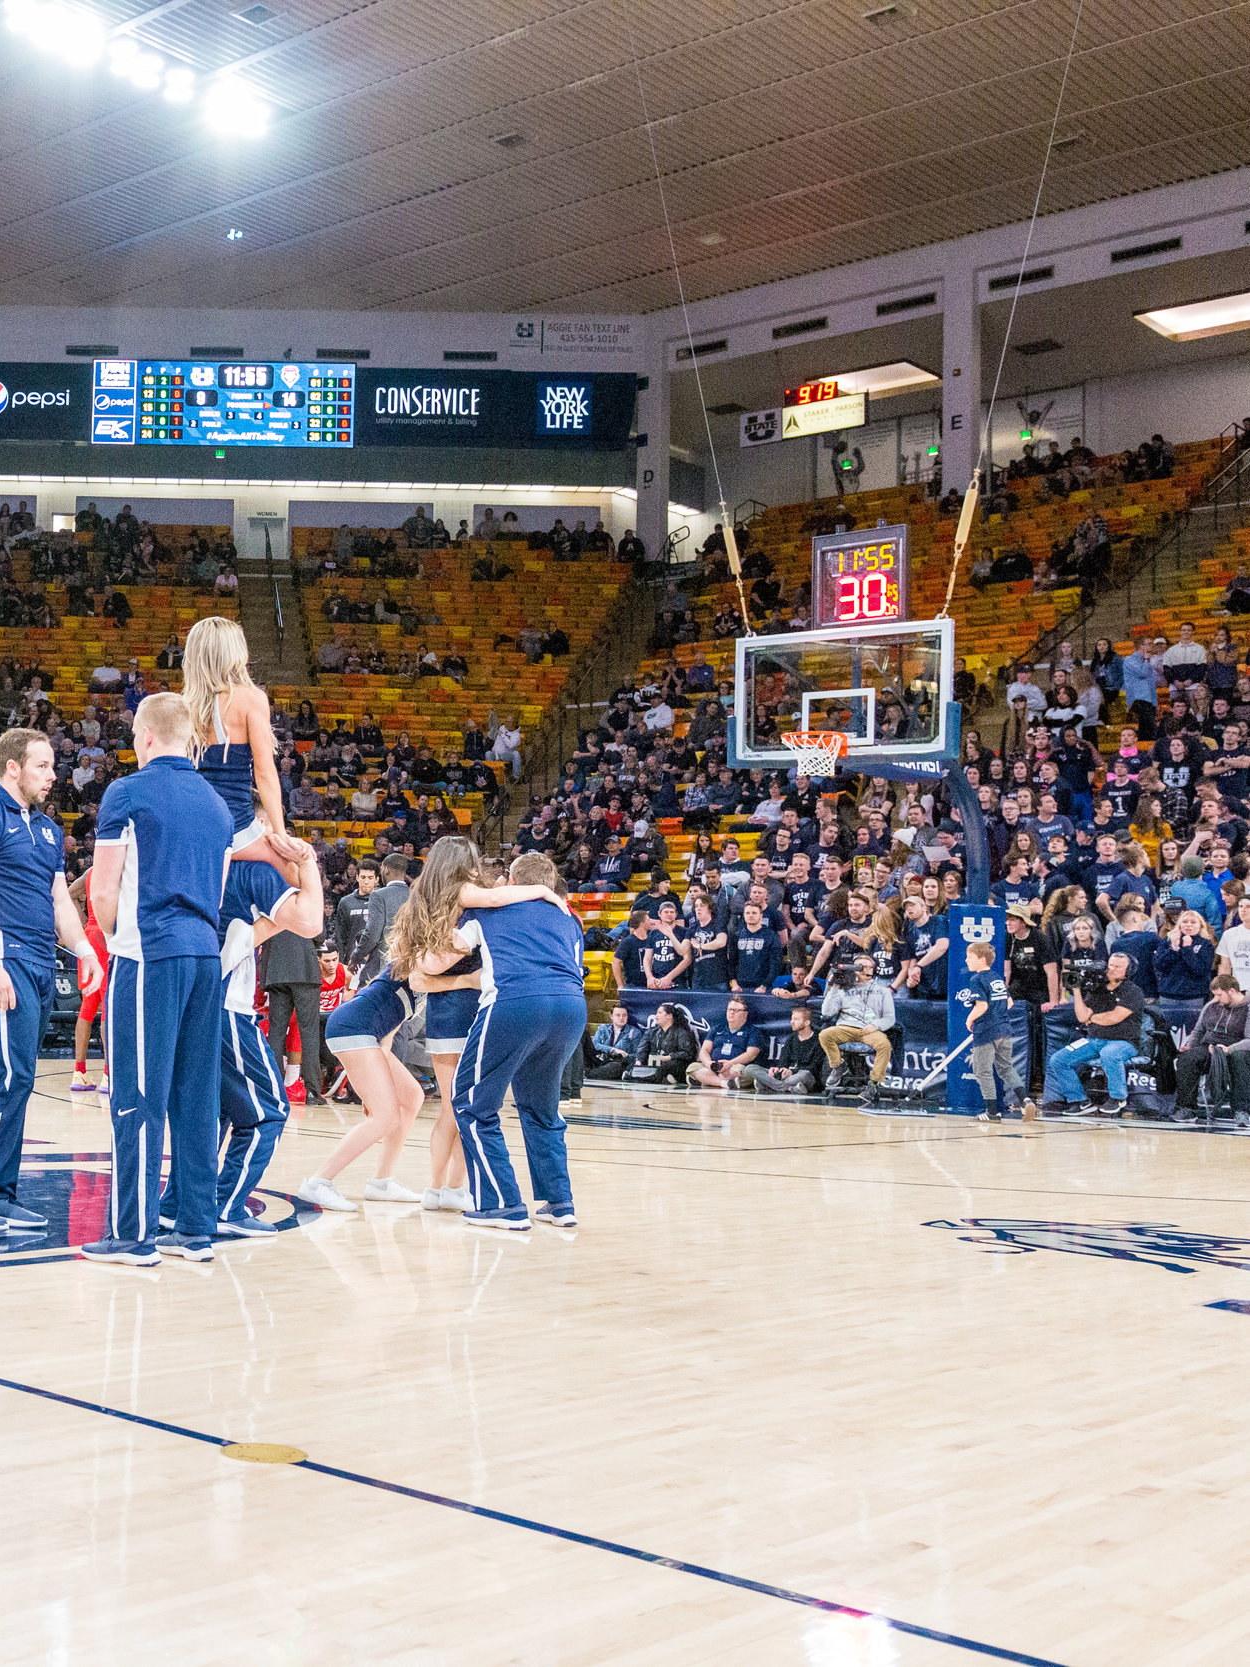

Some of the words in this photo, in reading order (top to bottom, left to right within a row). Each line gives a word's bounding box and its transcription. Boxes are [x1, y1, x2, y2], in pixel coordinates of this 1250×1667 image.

[161, 376, 167, 385] 2
[224, 366, 267, 387] 11:55
[328, 379, 334, 388] 2
[11, 389, 71, 409] pepsi
[256, 392, 262, 400] 1
[281, 392, 297, 407] 14
[327, 392, 333, 401] 3
[342, 392, 348, 401] 1
[546, 386, 586, 401] NEW
[375, 386, 480, 417] CONSERVICE
[540, 399, 589, 416] YORK
[802, 407, 830, 418] STAKER
[835, 400, 865, 413] PARSON
[342, 405, 348, 414] 1
[141, 416, 153, 425] 22
[173, 416, 180, 425] 1
[309, 418, 321, 428] 32
[395, 418, 447, 426] management
[455, 417, 478, 426] billing
[546, 414, 584, 429] LIFE
[951, 414, 963, 431] E
[643, 470, 654, 483] D
[838, 544, 894, 573] 11:55
[838, 573, 887, 621] 30
[1115, 797, 1124, 813] 1
